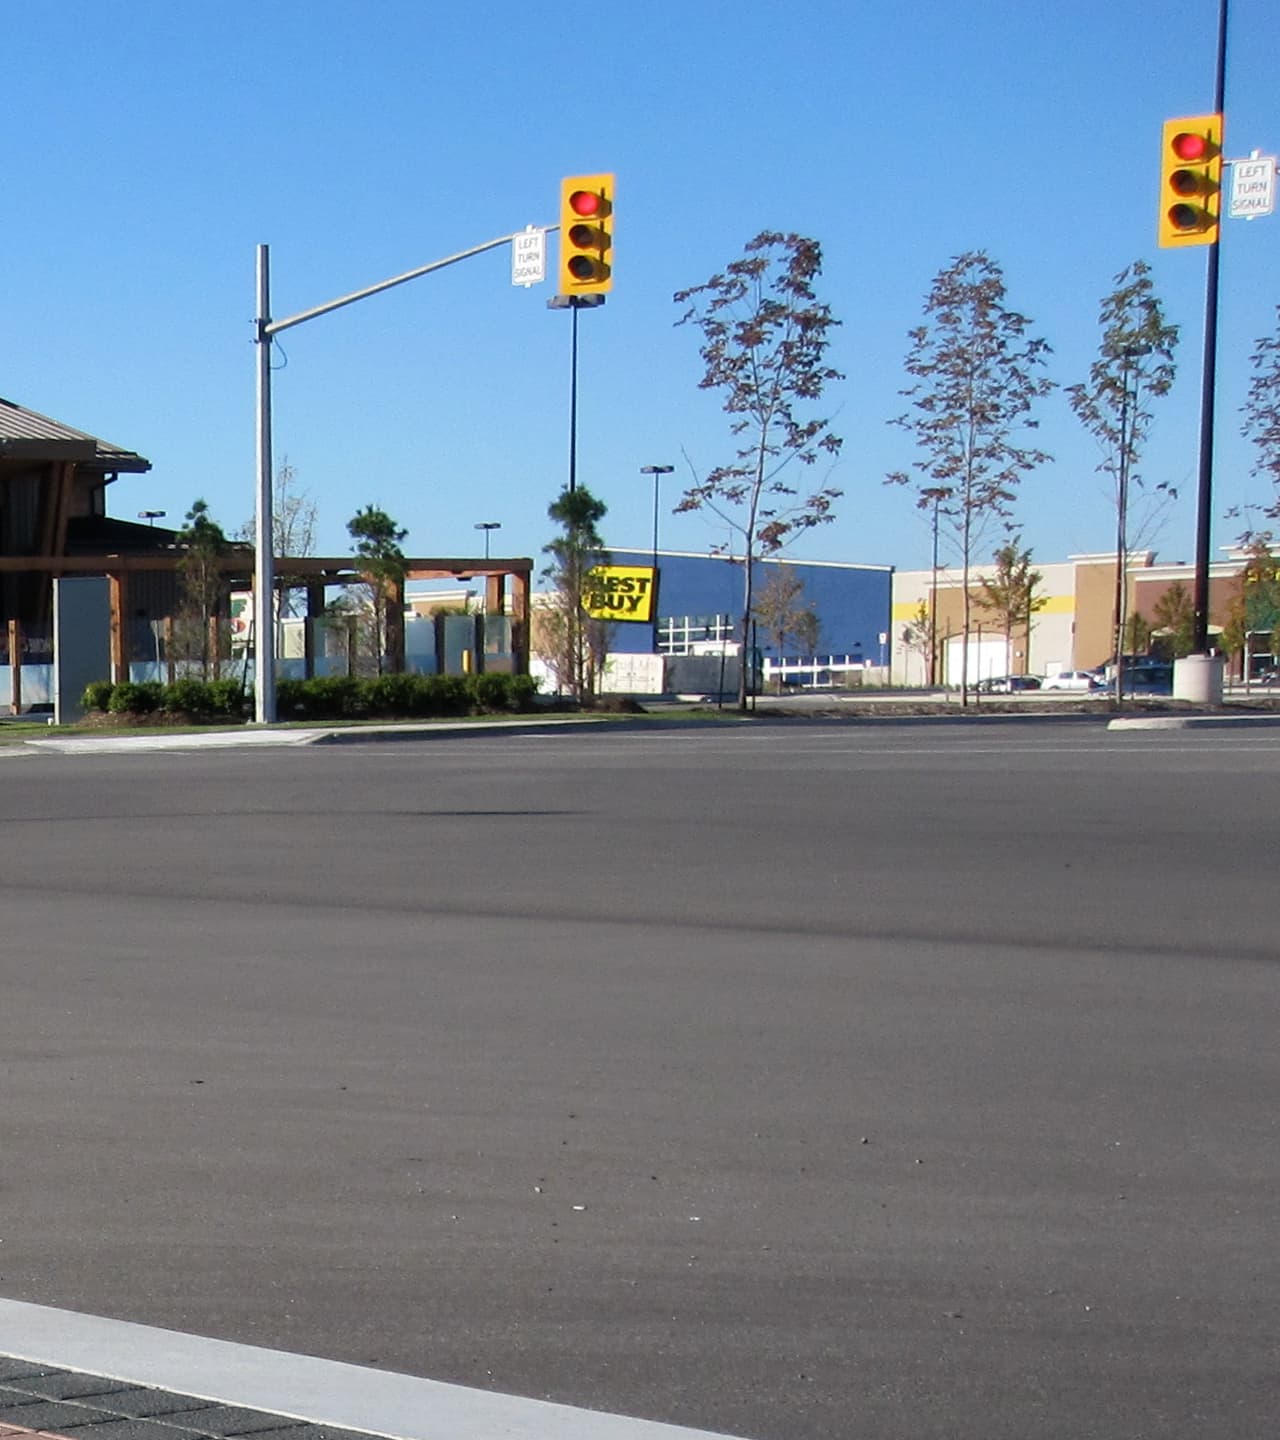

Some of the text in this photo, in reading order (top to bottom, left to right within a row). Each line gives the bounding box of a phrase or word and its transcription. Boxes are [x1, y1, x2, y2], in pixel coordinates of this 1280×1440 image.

[1239, 165, 1265, 178] LEFT
[1237, 182, 1268, 194] TURN
[1232, 198, 1271, 210] SIGNAL
[518, 237, 538, 250] LEFT
[518, 251, 540, 263] TURN
[513, 266, 541, 278] SIGNAL
[589, 576, 651, 594] EST
[591, 594, 644, 612] BUY
